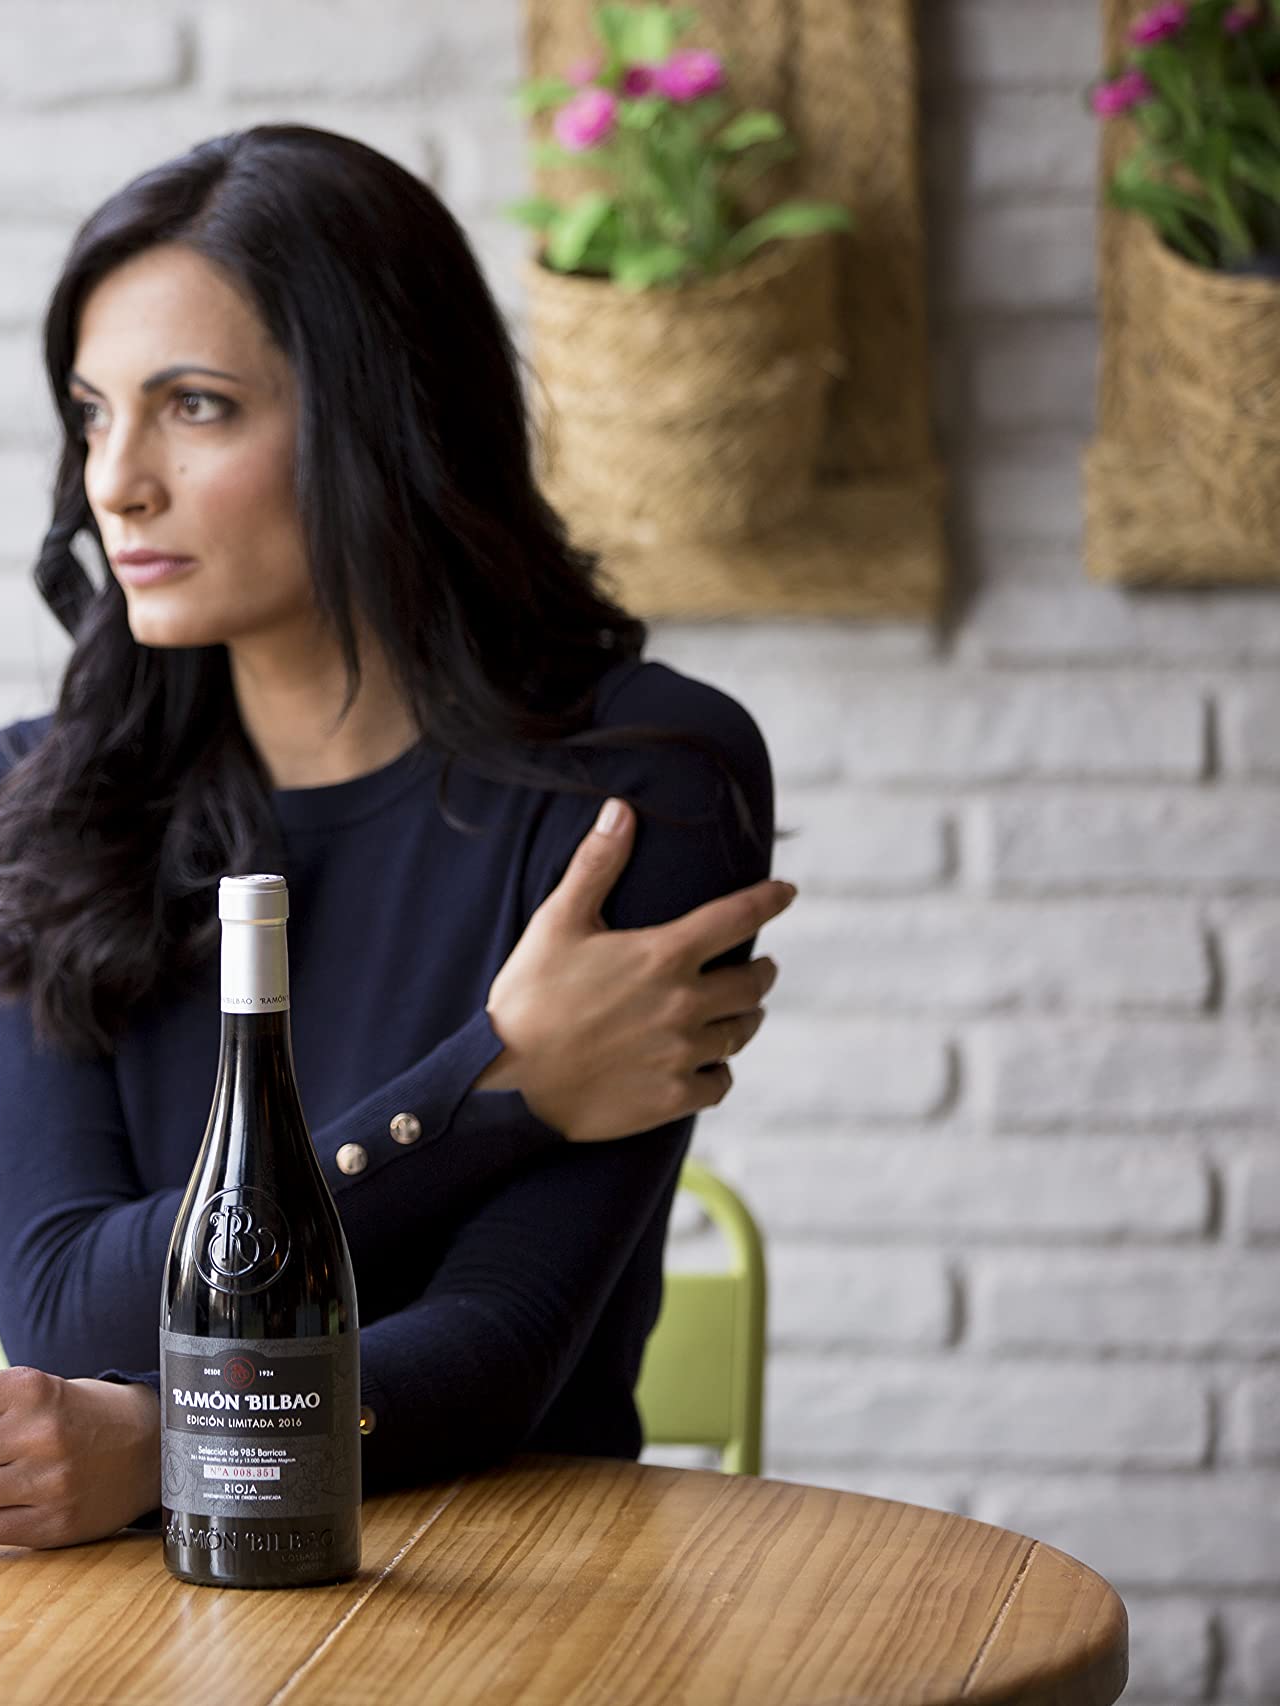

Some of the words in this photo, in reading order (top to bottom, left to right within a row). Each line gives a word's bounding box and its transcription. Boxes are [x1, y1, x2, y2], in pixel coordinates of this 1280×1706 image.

[203, 1368, 221, 1376] DESDE
[173, 1388, 240, 1411] RAMÓN
[244, 1392, 321, 1411] BILBAO
[186, 1414, 224, 1428] EDICIÓN
[228, 1418, 275, 1428] LIMITADA
[278, 1418, 302, 1428] 2016
[198, 1445, 228, 1456] Selección
[229, 1447, 239, 1456] de
[240, 1448, 256, 1457] 985
[257, 1448, 287, 1457] Barricas
[224, 1483, 257, 1494] RIOJA
